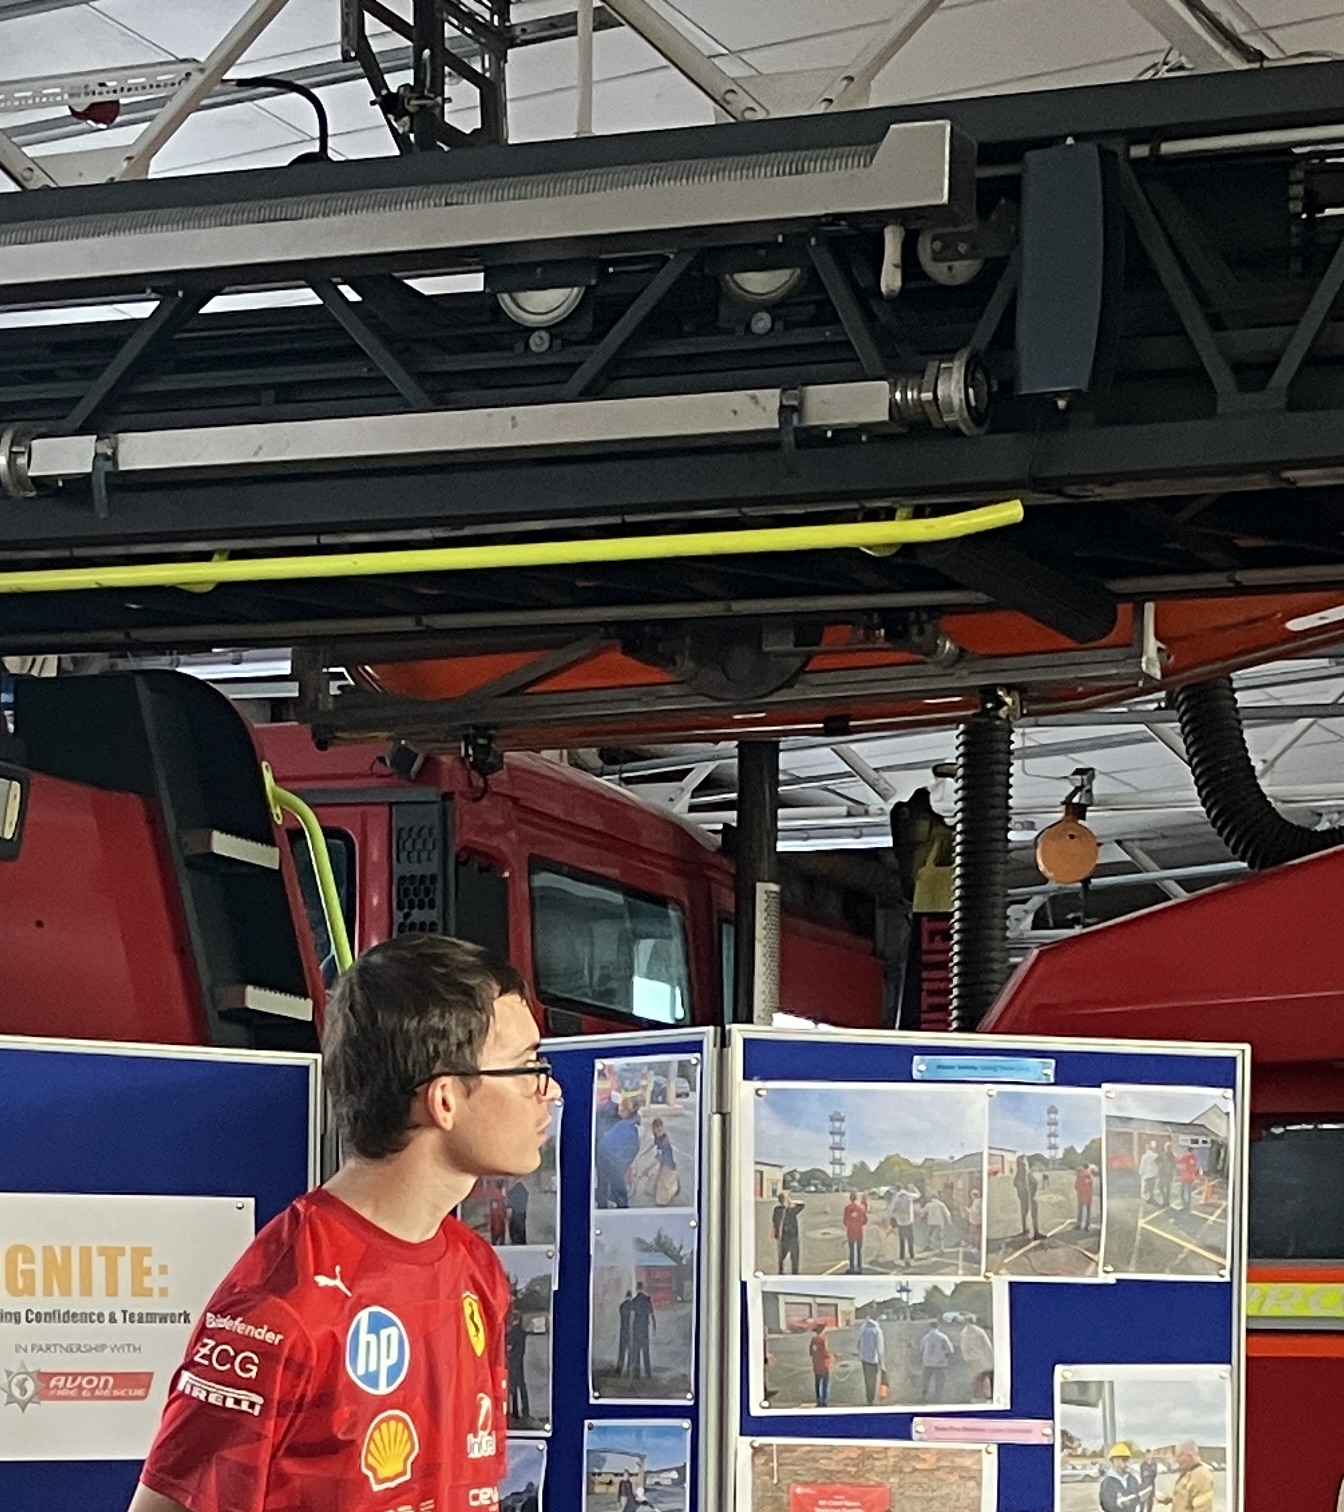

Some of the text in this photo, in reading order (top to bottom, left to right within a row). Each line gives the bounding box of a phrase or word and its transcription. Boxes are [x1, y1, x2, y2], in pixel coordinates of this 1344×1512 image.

[25, 1308, 106, 1324] Confidence
[108, 1309, 118, 1324] &
[121, 1309, 192, 1324] Teamwork
[205, 1311, 284, 1346] Bdefender
[14, 1343, 142, 1354] IN PARTNERSHIP WITH
[193, 1337, 260, 1379] ZCG
[357, 1309, 399, 1391] hp
[49, 1374, 114, 1389] AVON
[94, 1388, 147, 1398] RESCUE
[177, 1369, 265, 1417] PIRELLI
